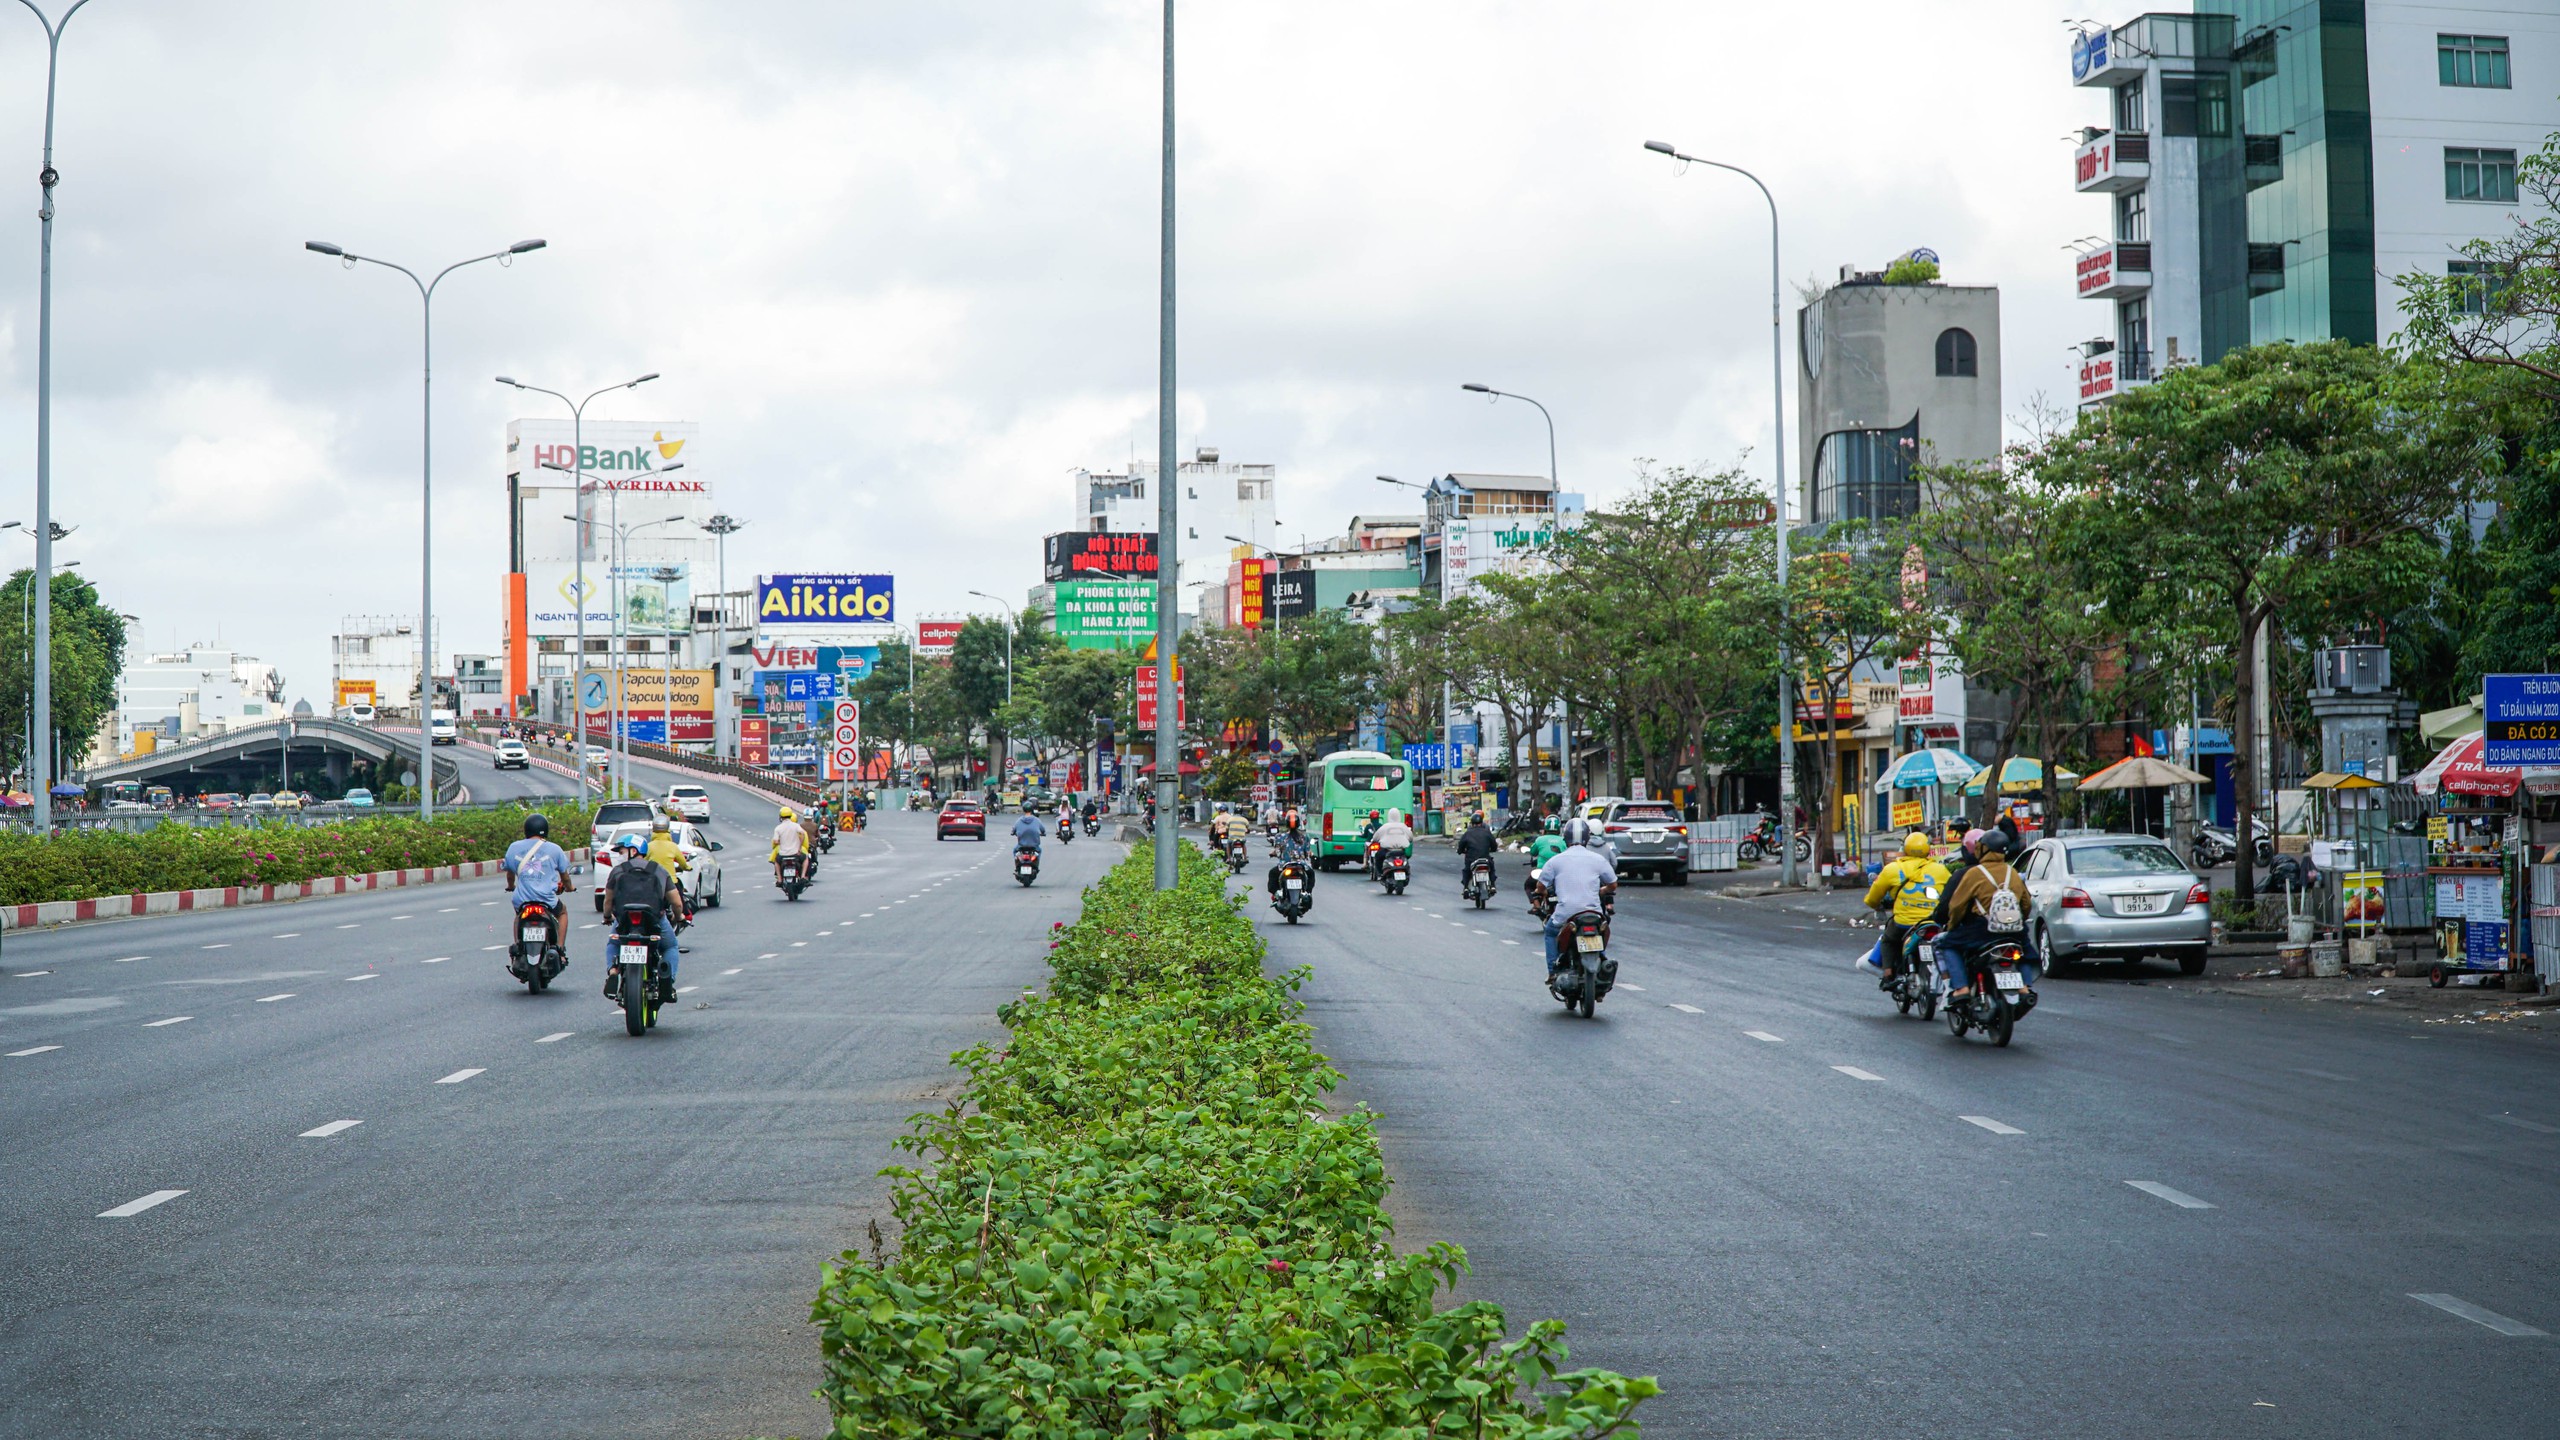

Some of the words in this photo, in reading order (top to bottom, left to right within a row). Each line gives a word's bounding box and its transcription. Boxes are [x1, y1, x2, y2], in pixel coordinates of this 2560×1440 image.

[534, 444, 652, 470] HDBank
[605, 480, 705, 492] AGRIBANK
[1244, 564, 1260, 576] ANH
[1077, 584, 1114, 598] PHÒNG
[1117, 584, 1150, 598] KHÁM
[761, 586, 889, 616] Aikido
[1066, 602, 1081, 612] ĐA
[1085, 602, 1114, 612] KHOA
[1082, 614, 1113, 627] HÀNG
[1116, 616, 1147, 627] XANH
[752, 645, 817, 669] VIỆN
[2522, 679, 2540, 694] TRÊN
[2500, 700, 2509, 716] TỪ
[2527, 700, 2543, 716] NĂM
[2544, 704, 2559, 716] 2020
[841, 731, 851, 739] 50
[2508, 723, 2526, 739] ĐÃ
[2530, 722, 2547, 739] CÓ
[2490, 749, 2500, 760] DO
[2522, 748, 2546, 760] NGANG
